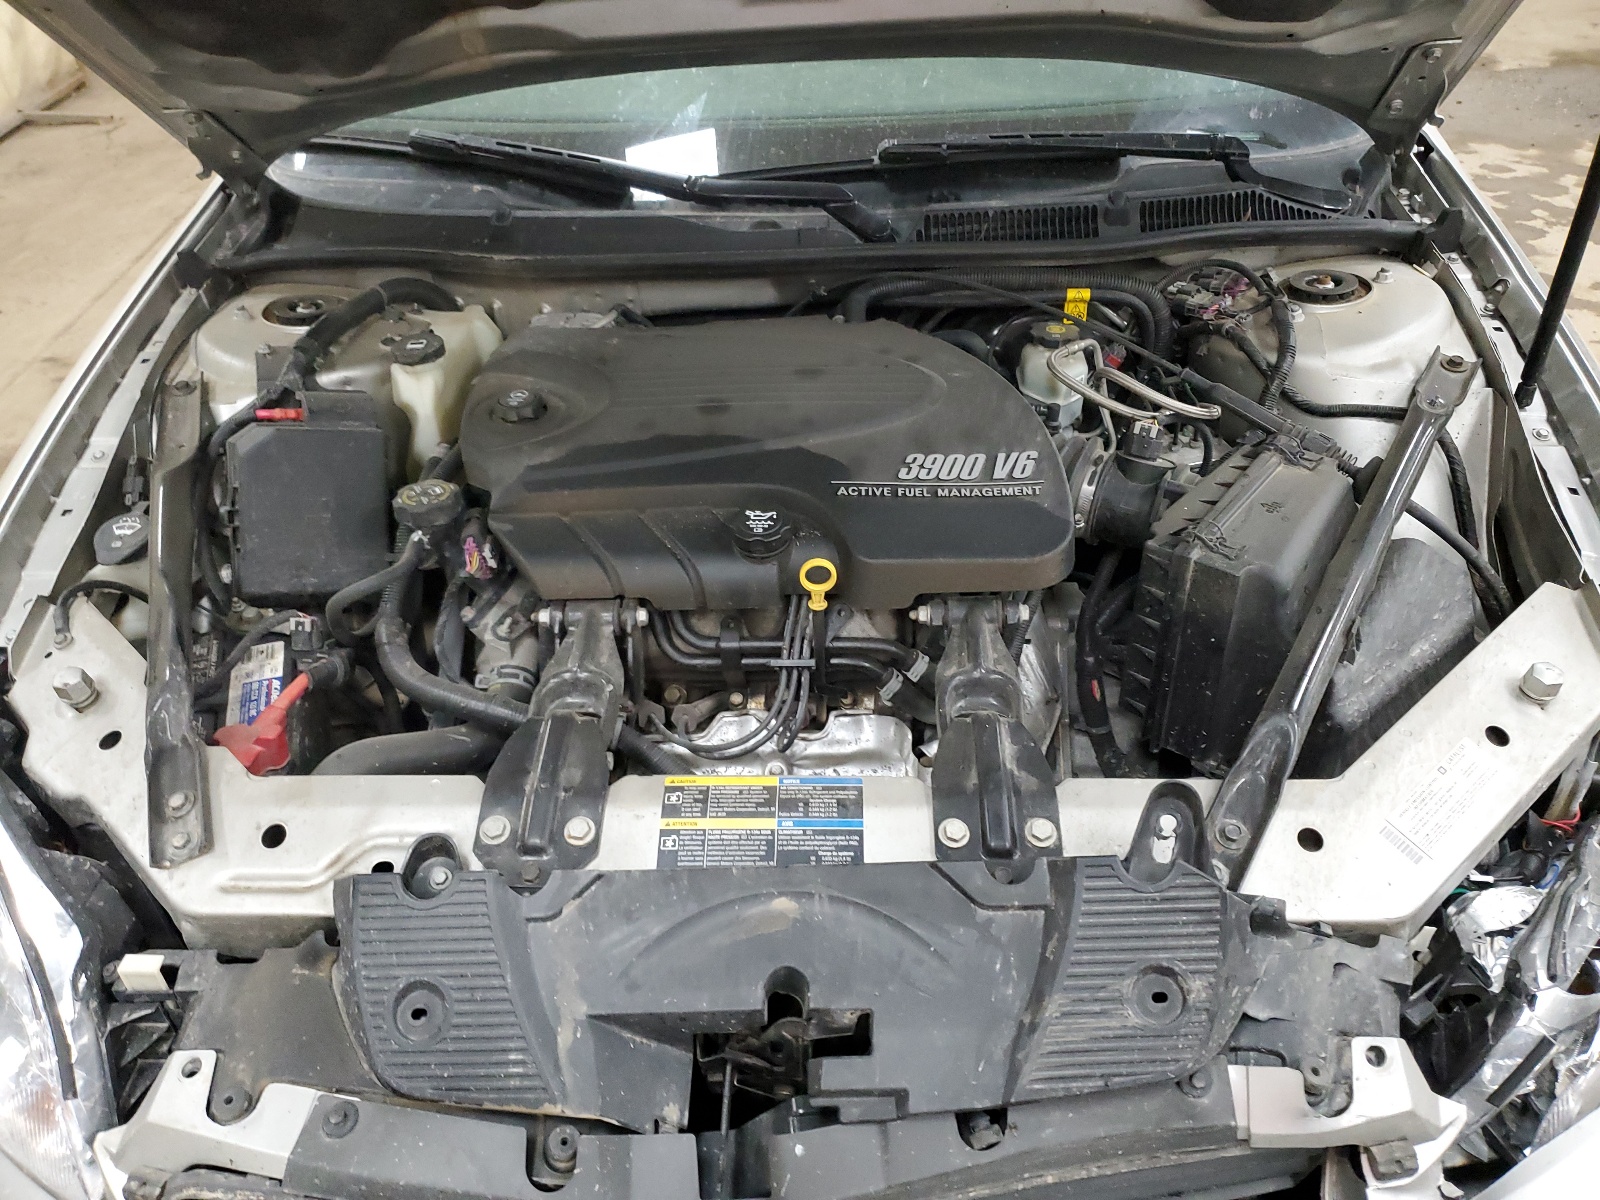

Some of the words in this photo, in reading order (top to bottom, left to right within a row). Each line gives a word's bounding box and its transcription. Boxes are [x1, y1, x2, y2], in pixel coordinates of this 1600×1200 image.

[897, 453, 986, 481] 3900
[992, 450, 1039, 480] V6
[836, 486, 892, 498] ACTIVE
[897, 486, 932, 498] FUEL
[937, 485, 1043, 498] MANAGEMENT
